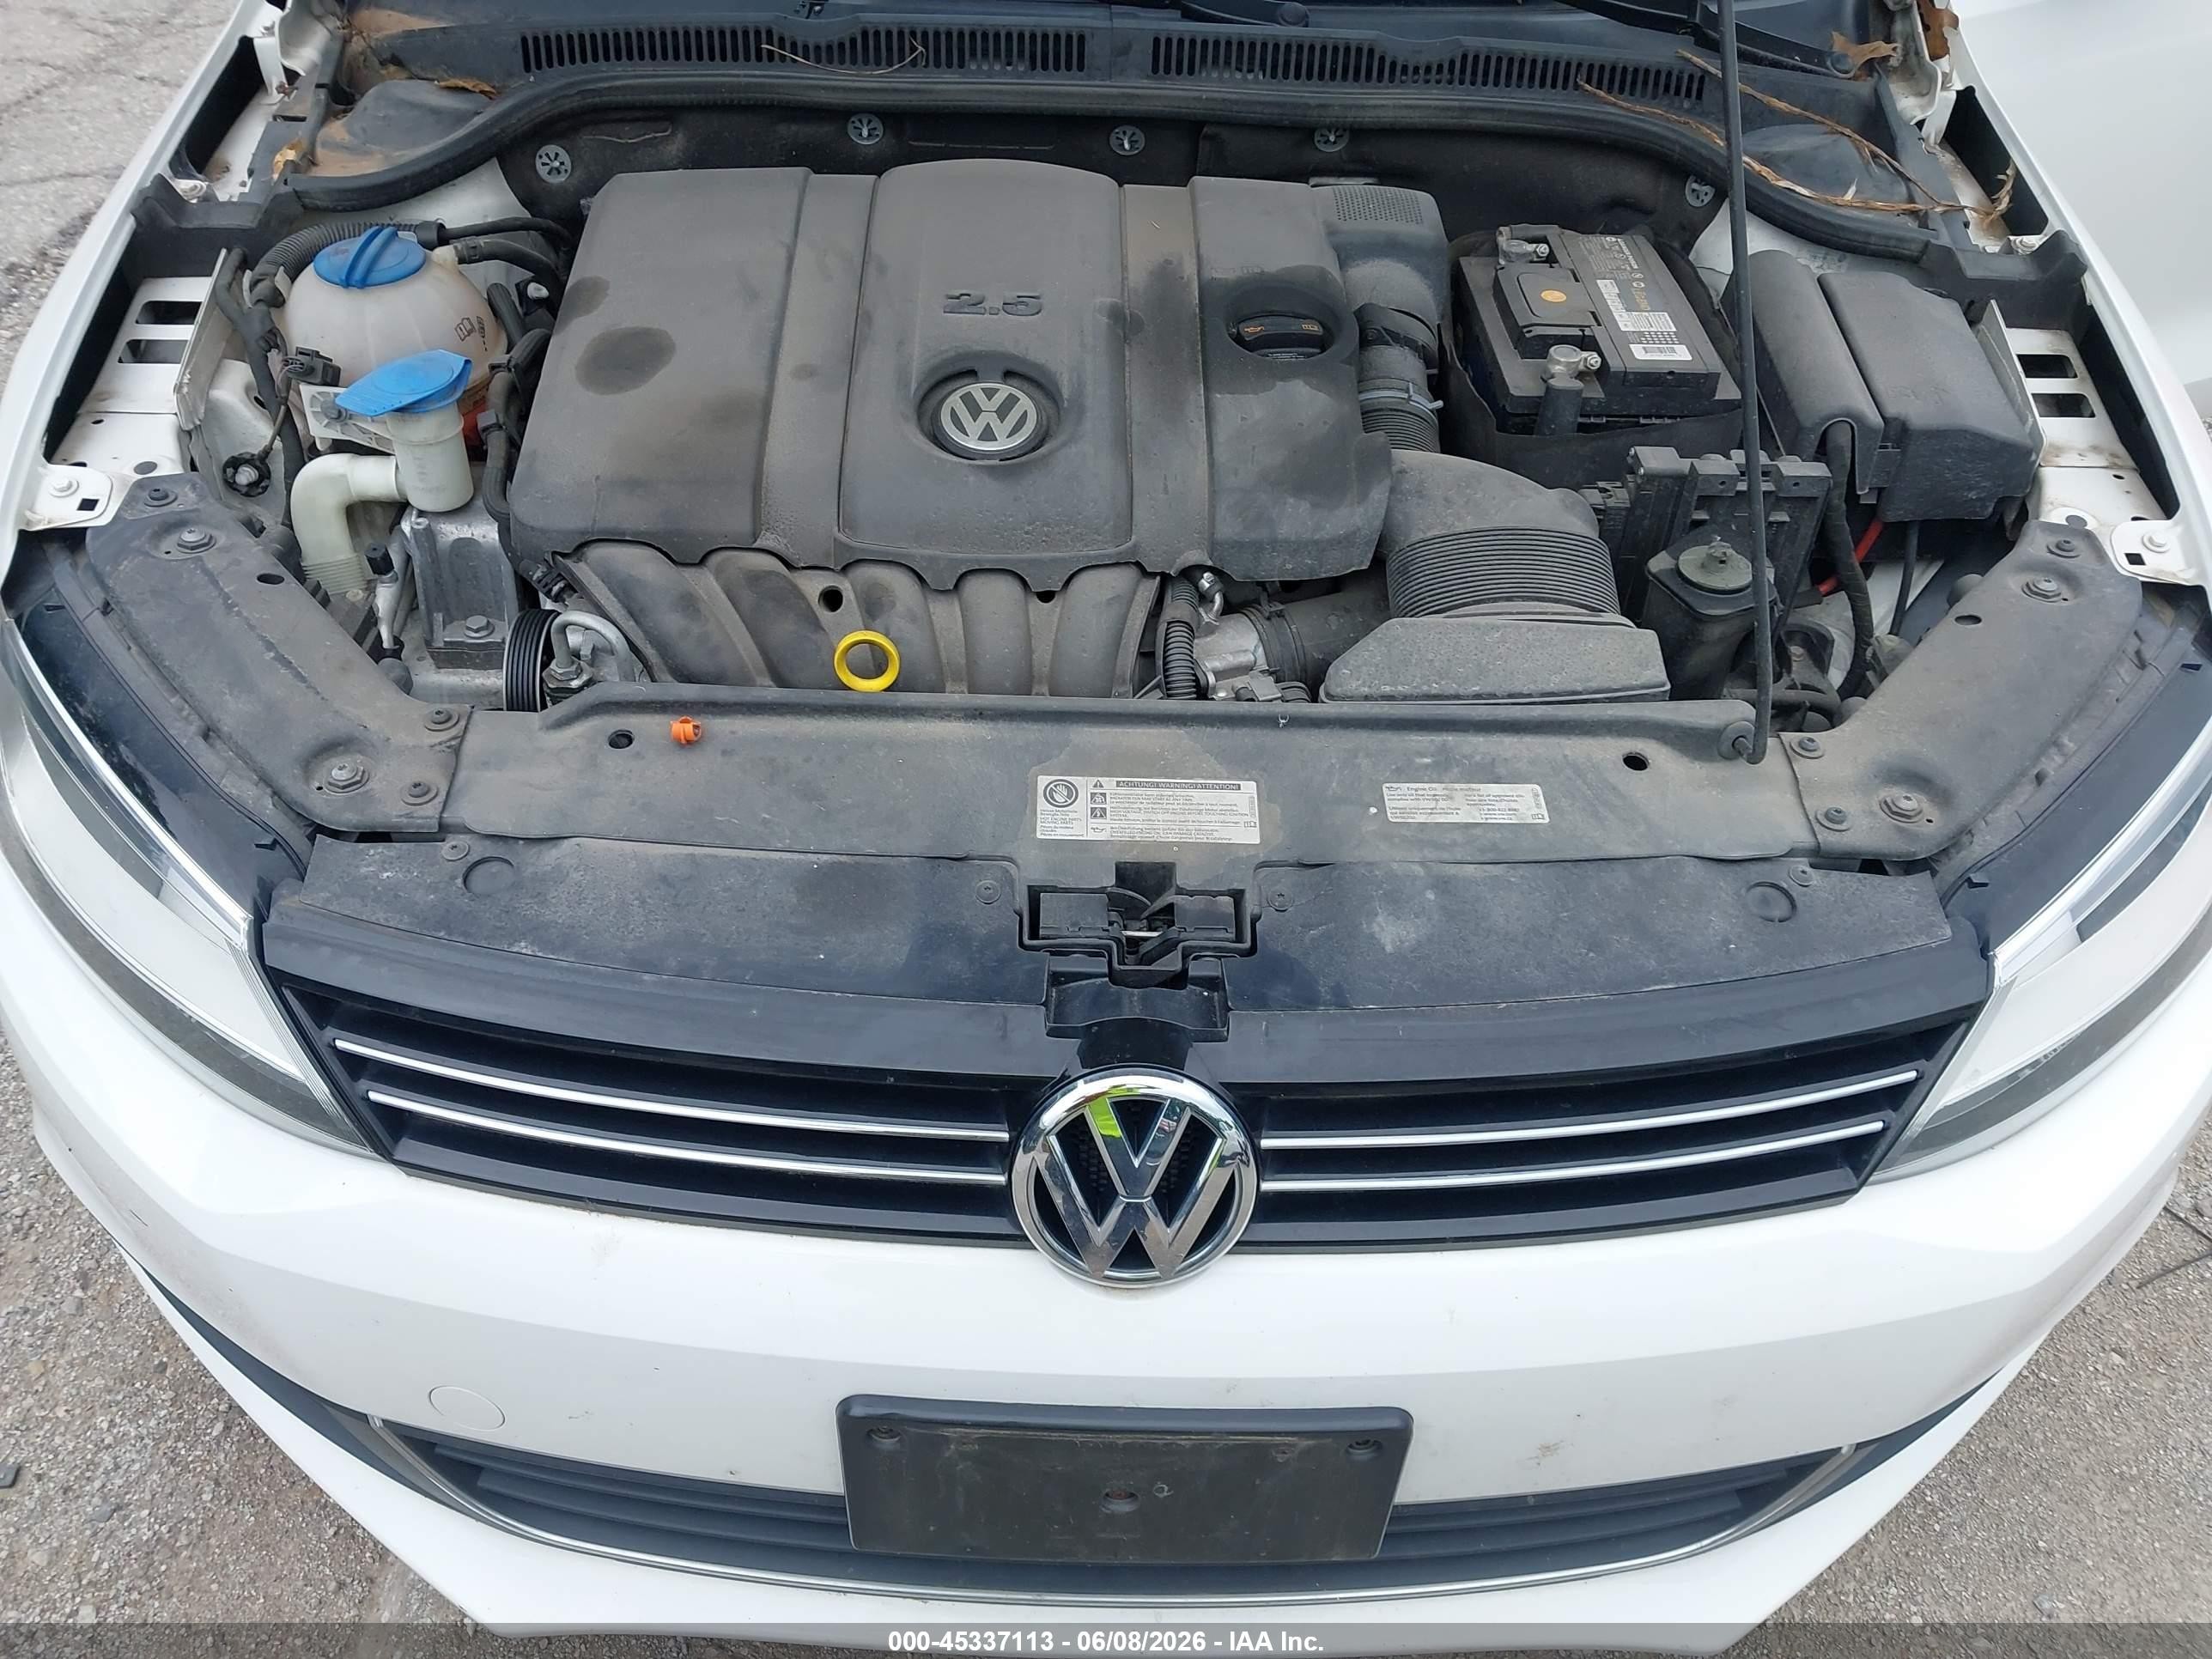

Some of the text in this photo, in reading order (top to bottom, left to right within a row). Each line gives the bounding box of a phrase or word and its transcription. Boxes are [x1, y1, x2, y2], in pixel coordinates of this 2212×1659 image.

[943, 292, 1042, 316] 2.5
[941, 383, 1037, 451] VW
[1018, 1079, 1250, 1285] VW
